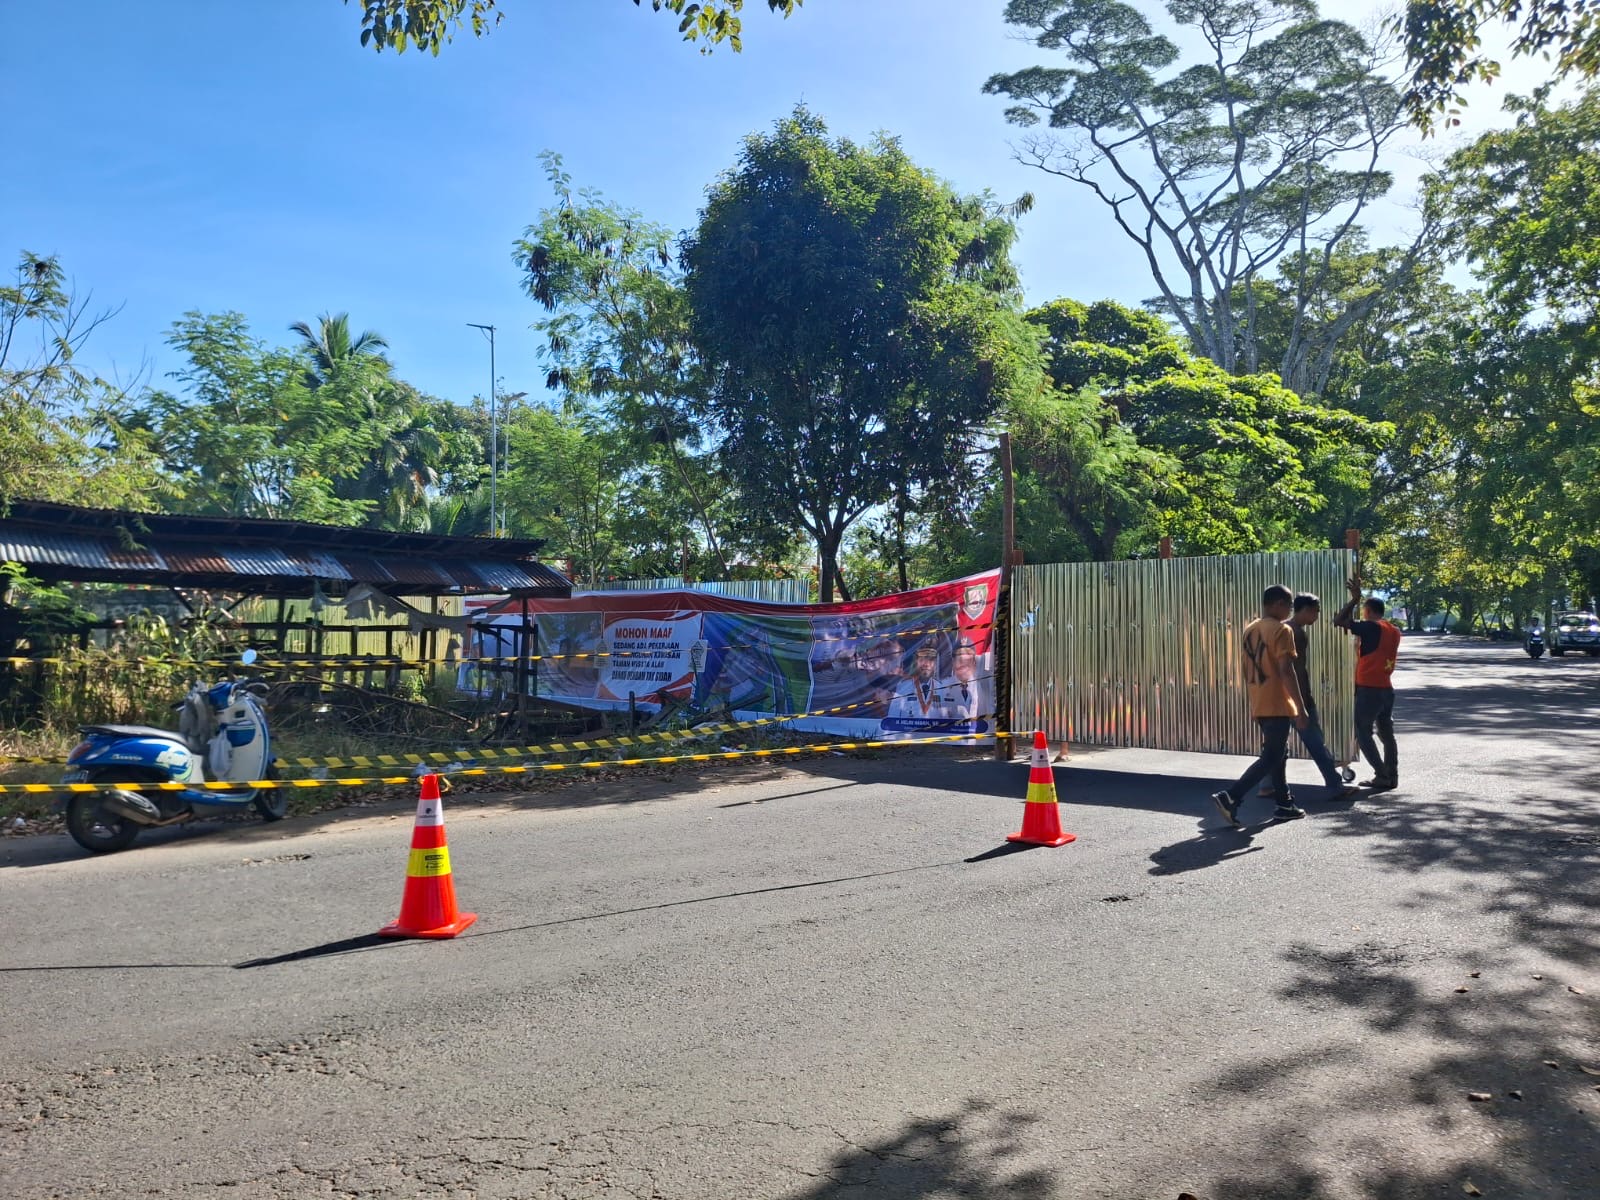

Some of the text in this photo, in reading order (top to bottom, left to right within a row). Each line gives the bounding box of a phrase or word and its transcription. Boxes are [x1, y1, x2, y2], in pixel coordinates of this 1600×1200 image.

[615, 628, 672, 638] MOHON MAAF
[647, 642, 680, 650] PEKERJAAN
